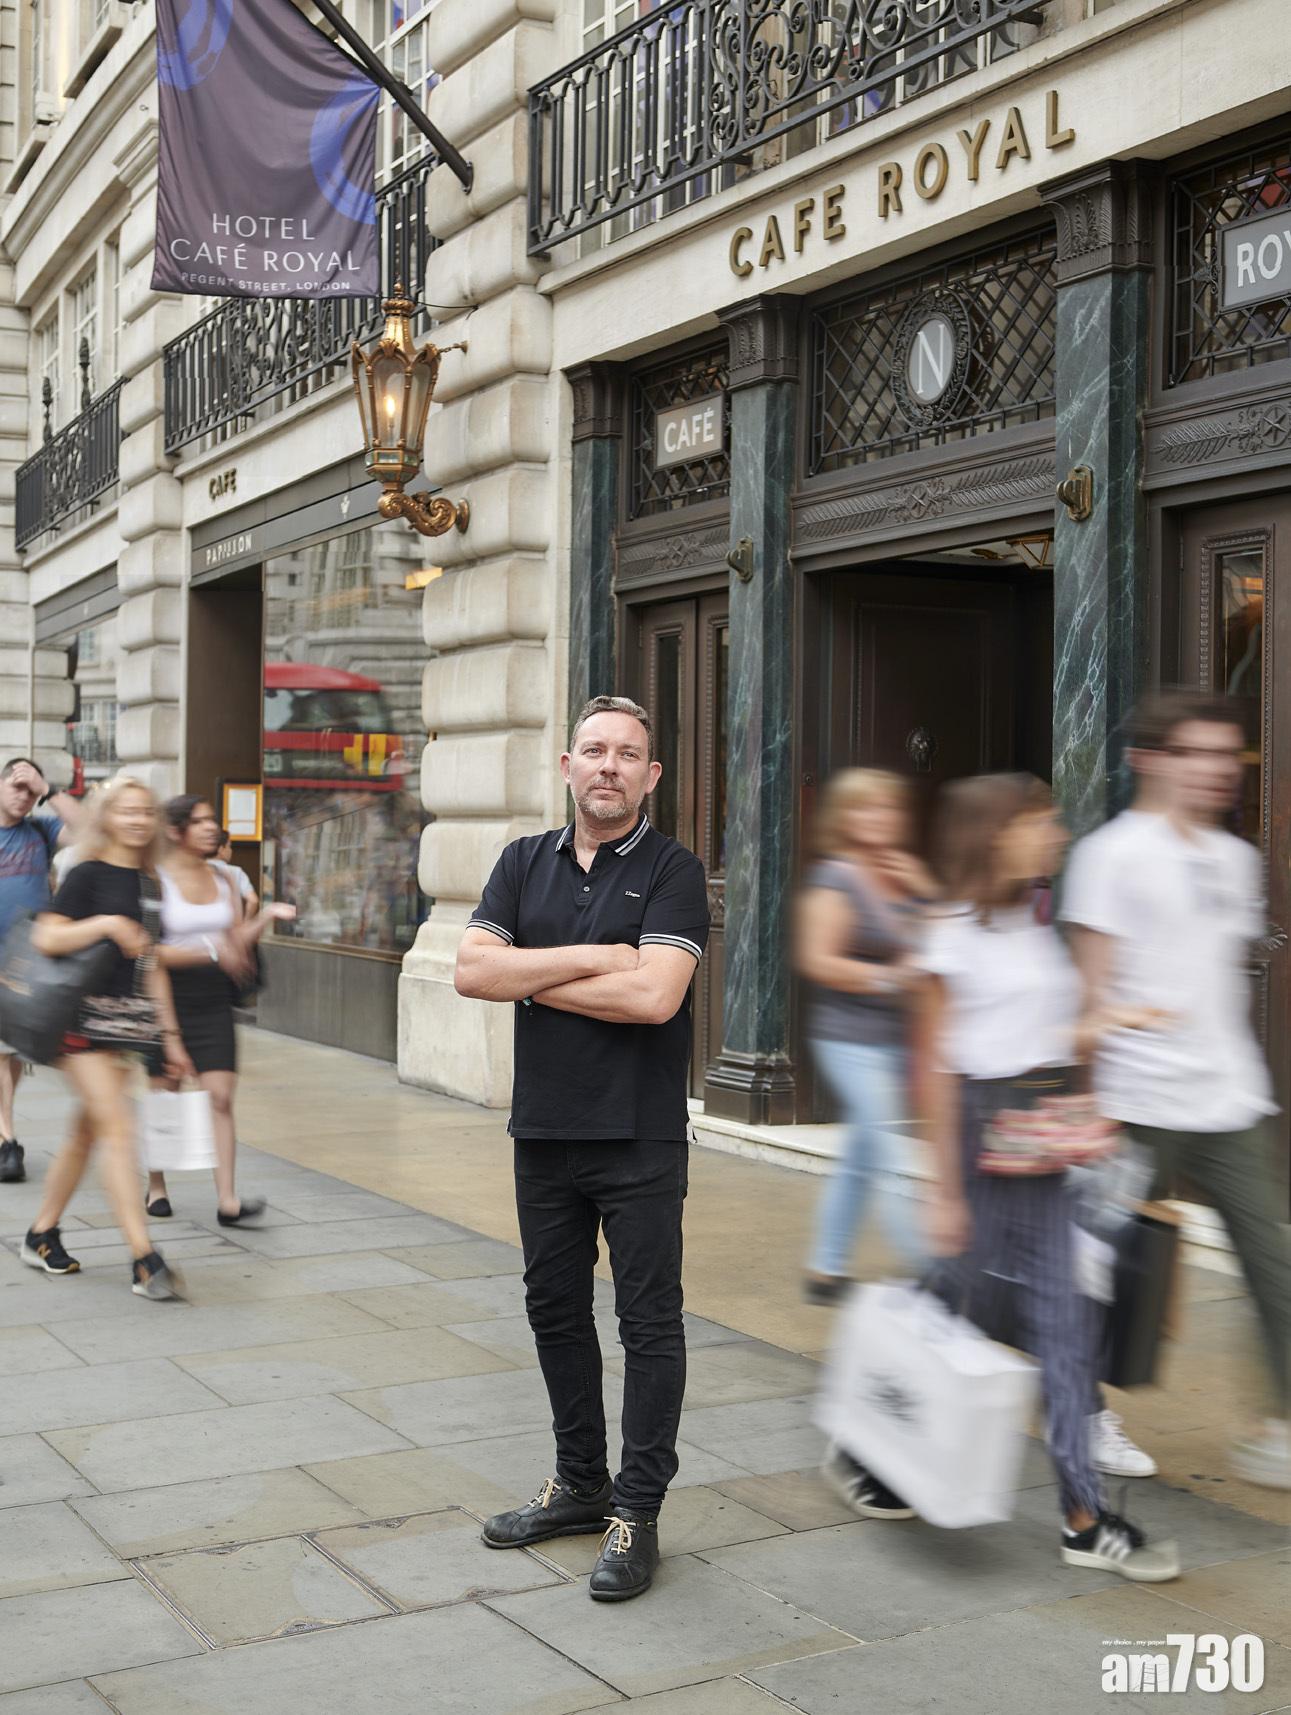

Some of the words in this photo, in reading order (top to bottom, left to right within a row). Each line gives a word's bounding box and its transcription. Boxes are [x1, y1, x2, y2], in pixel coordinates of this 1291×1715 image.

[729, 183, 846, 276] CAFE
[878, 90, 1075, 217] ROYAL
[212, 213, 315, 241] HOTEL
[170, 238, 249, 270] CAFÉ
[263, 250, 361, 273] ROYAL
[1236, 230, 1291, 288] RO
[181, 272, 235, 287] REGENT
[296, 281, 350, 292] LONDON
[916, 323, 946, 395] N
[664, 407, 715, 453] CAFÉ
[208, 468, 237, 502] CAFE
